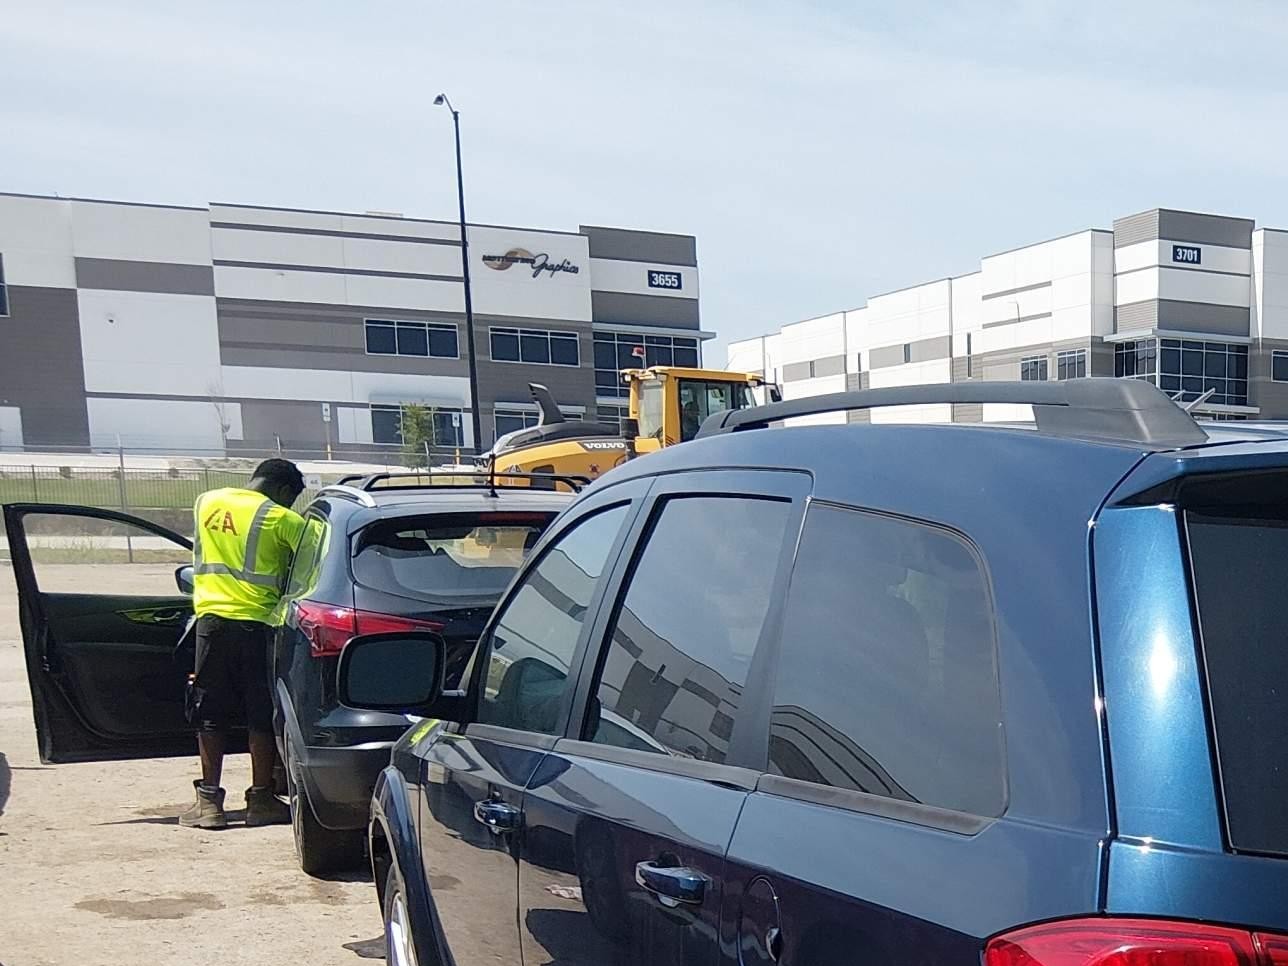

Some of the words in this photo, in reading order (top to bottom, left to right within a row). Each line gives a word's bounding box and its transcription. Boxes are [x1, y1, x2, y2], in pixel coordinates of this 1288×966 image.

[1176, 248, 1198, 261] 3701
[651, 273, 679, 287] 3655
[584, 442, 625, 450] VOLVO
